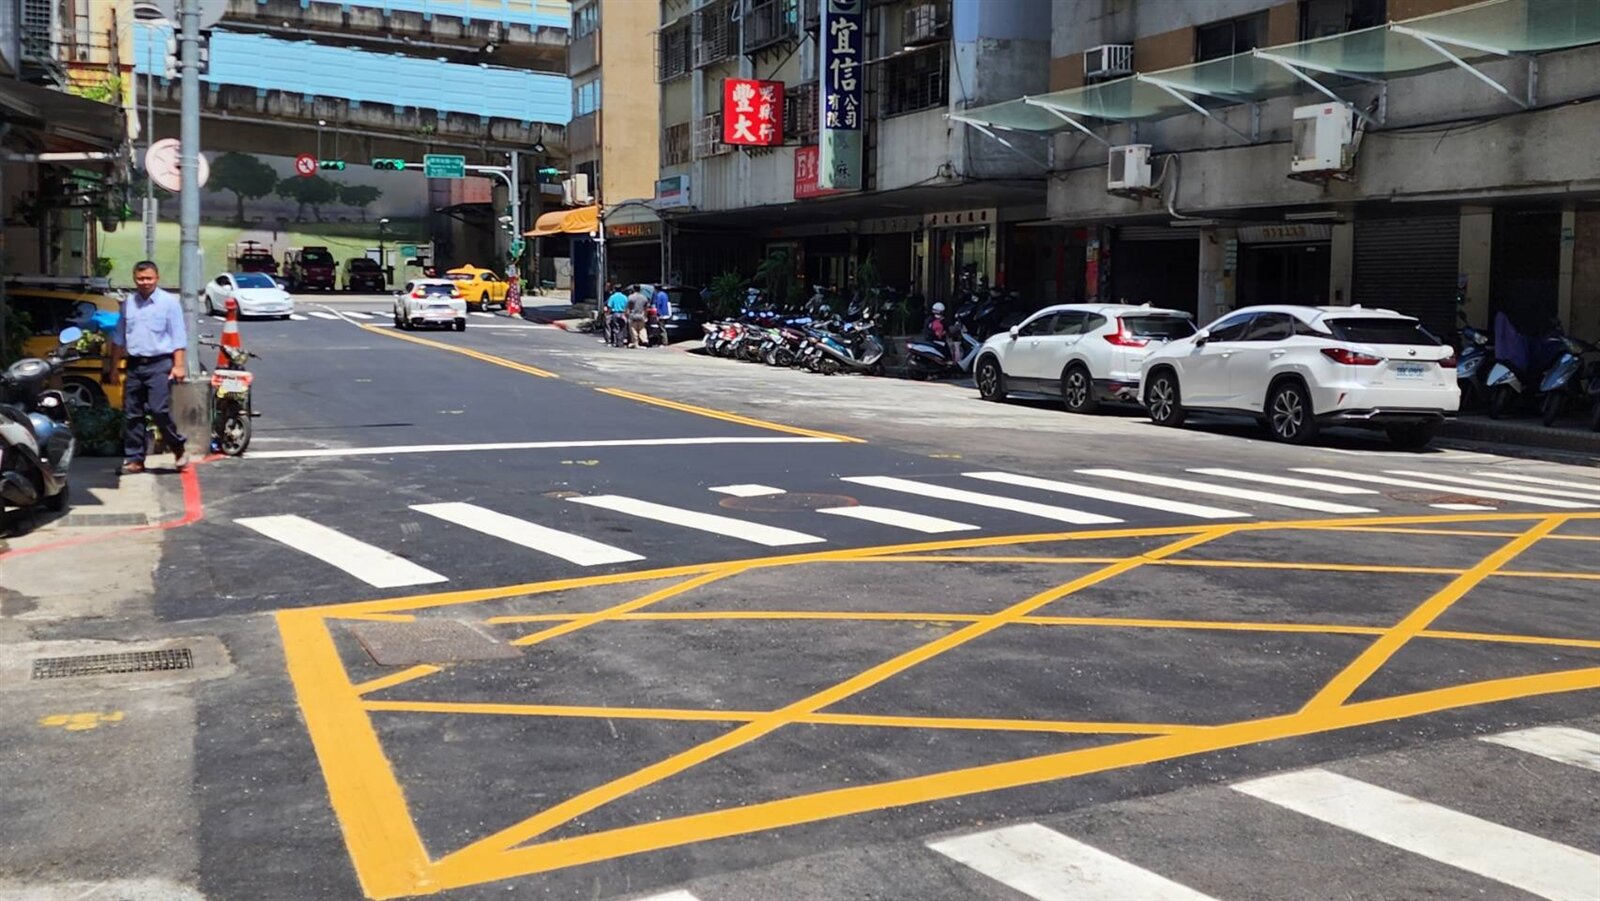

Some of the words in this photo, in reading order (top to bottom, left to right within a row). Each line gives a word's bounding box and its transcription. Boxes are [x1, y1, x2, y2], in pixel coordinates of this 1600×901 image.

[829, 16, 858, 92] 宜信
[732, 82, 757, 143] 豐大
[826, 93, 842, 128] 有限
[844, 93, 859, 129] 公司
